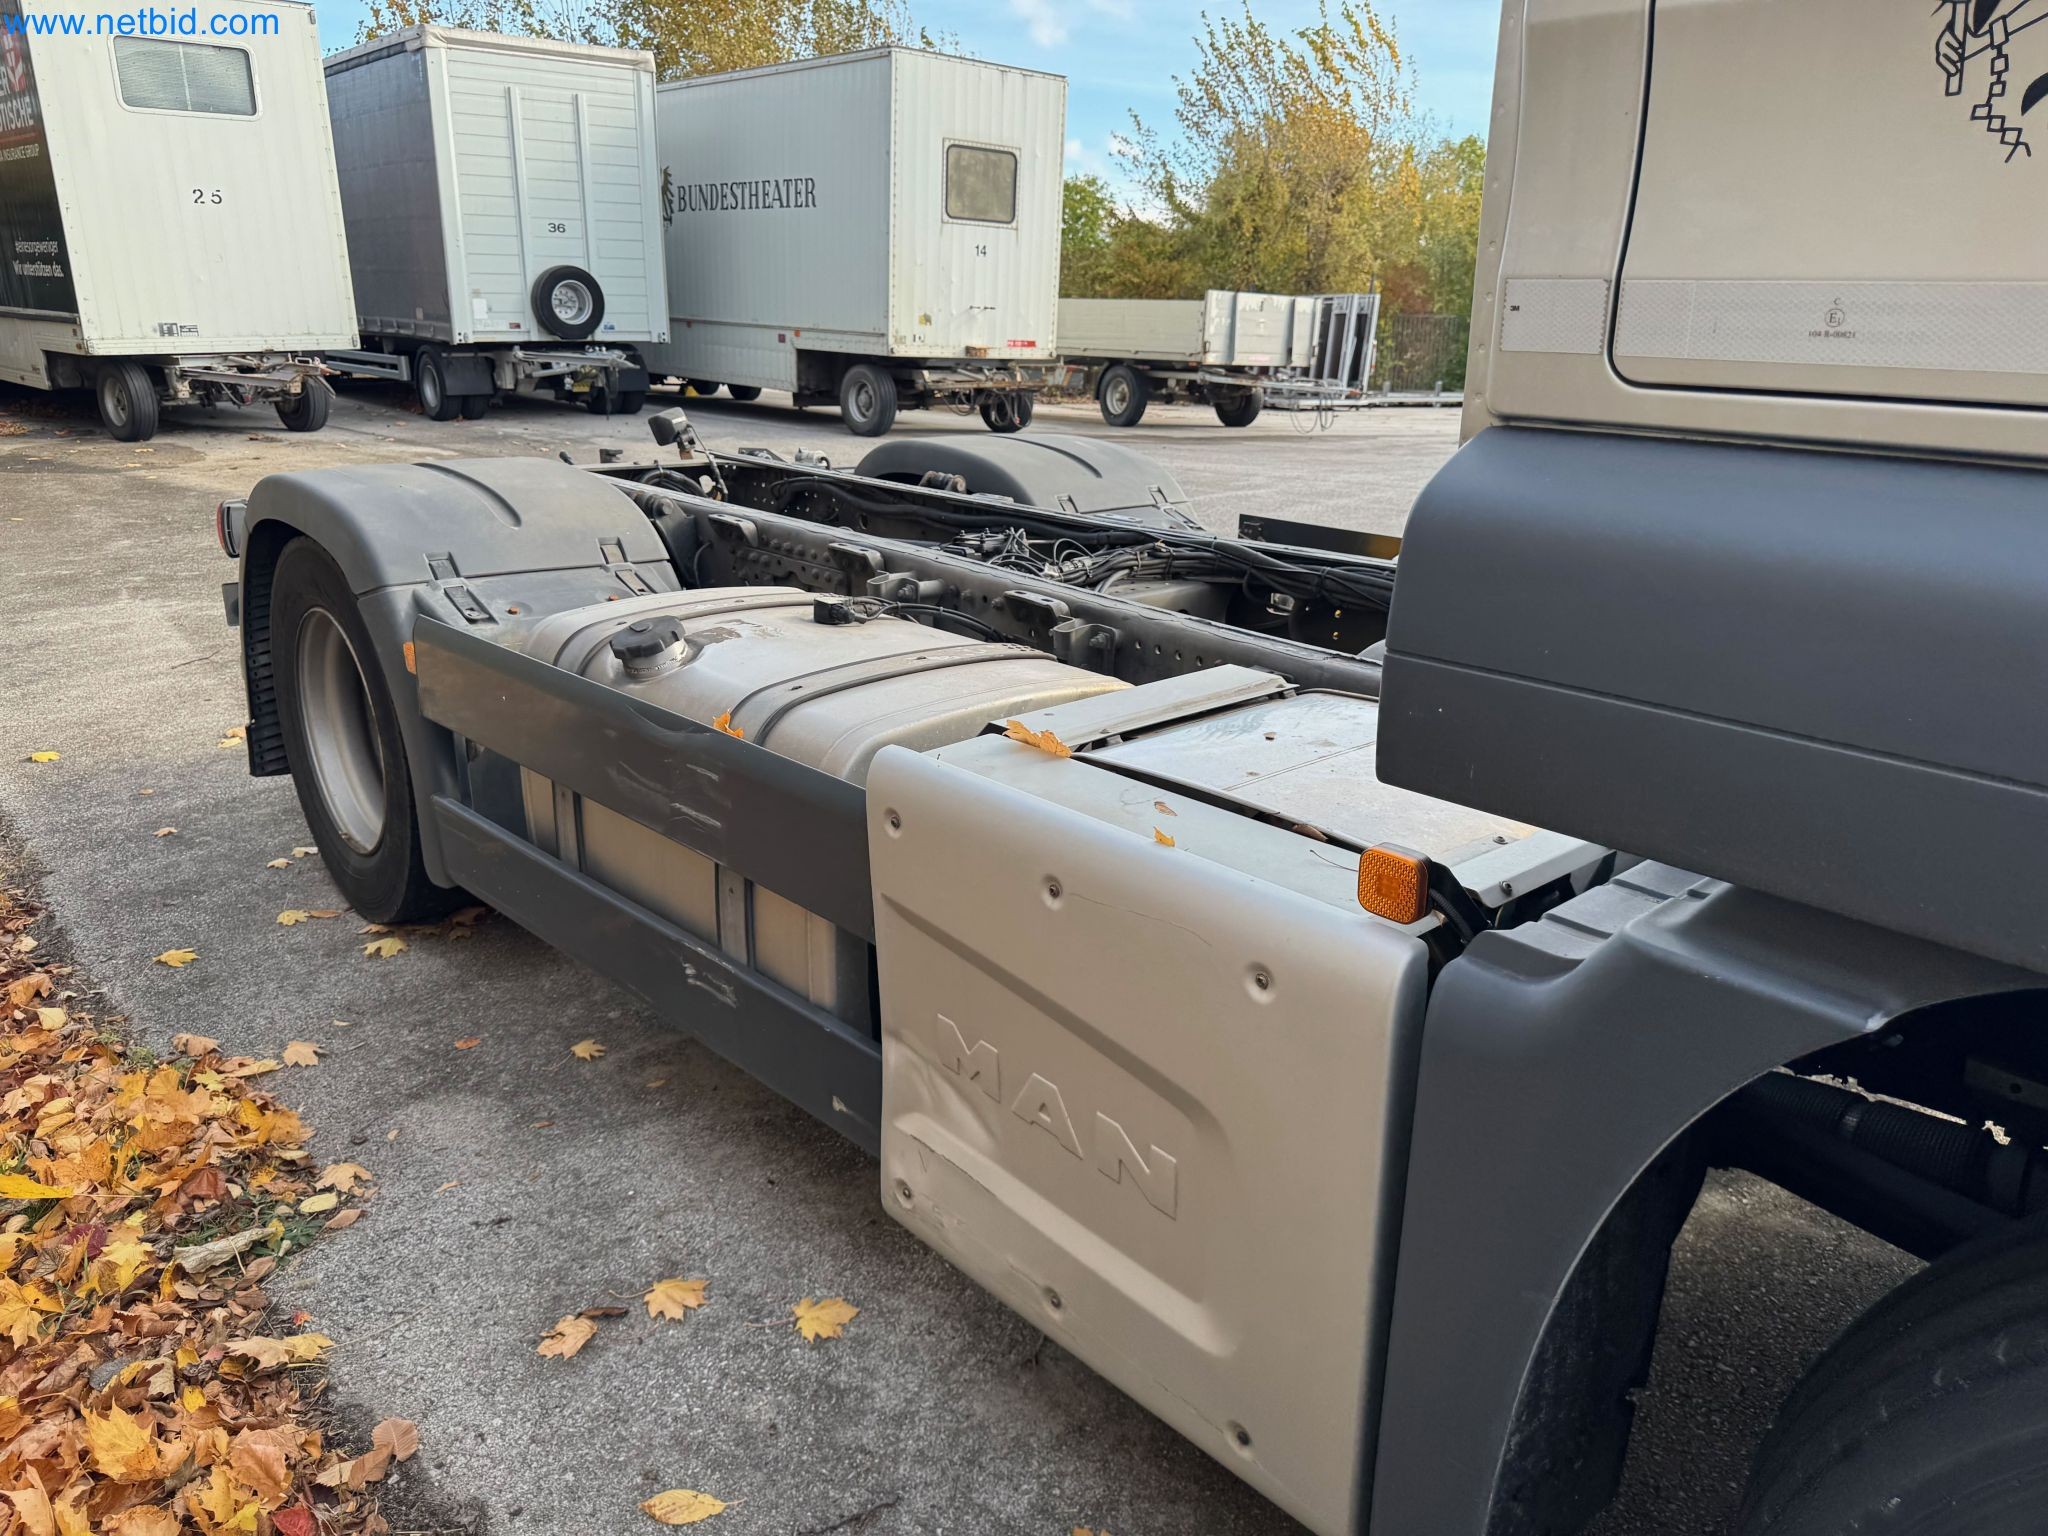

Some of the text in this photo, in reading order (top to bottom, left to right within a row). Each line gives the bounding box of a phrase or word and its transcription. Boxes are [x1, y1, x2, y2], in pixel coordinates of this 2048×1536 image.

[677, 177, 817, 213] BUNDESTHEATER
[547, 222, 566, 233] 36
[974, 243, 987, 258] 14
[937, 1013, 1178, 1222] MAN
